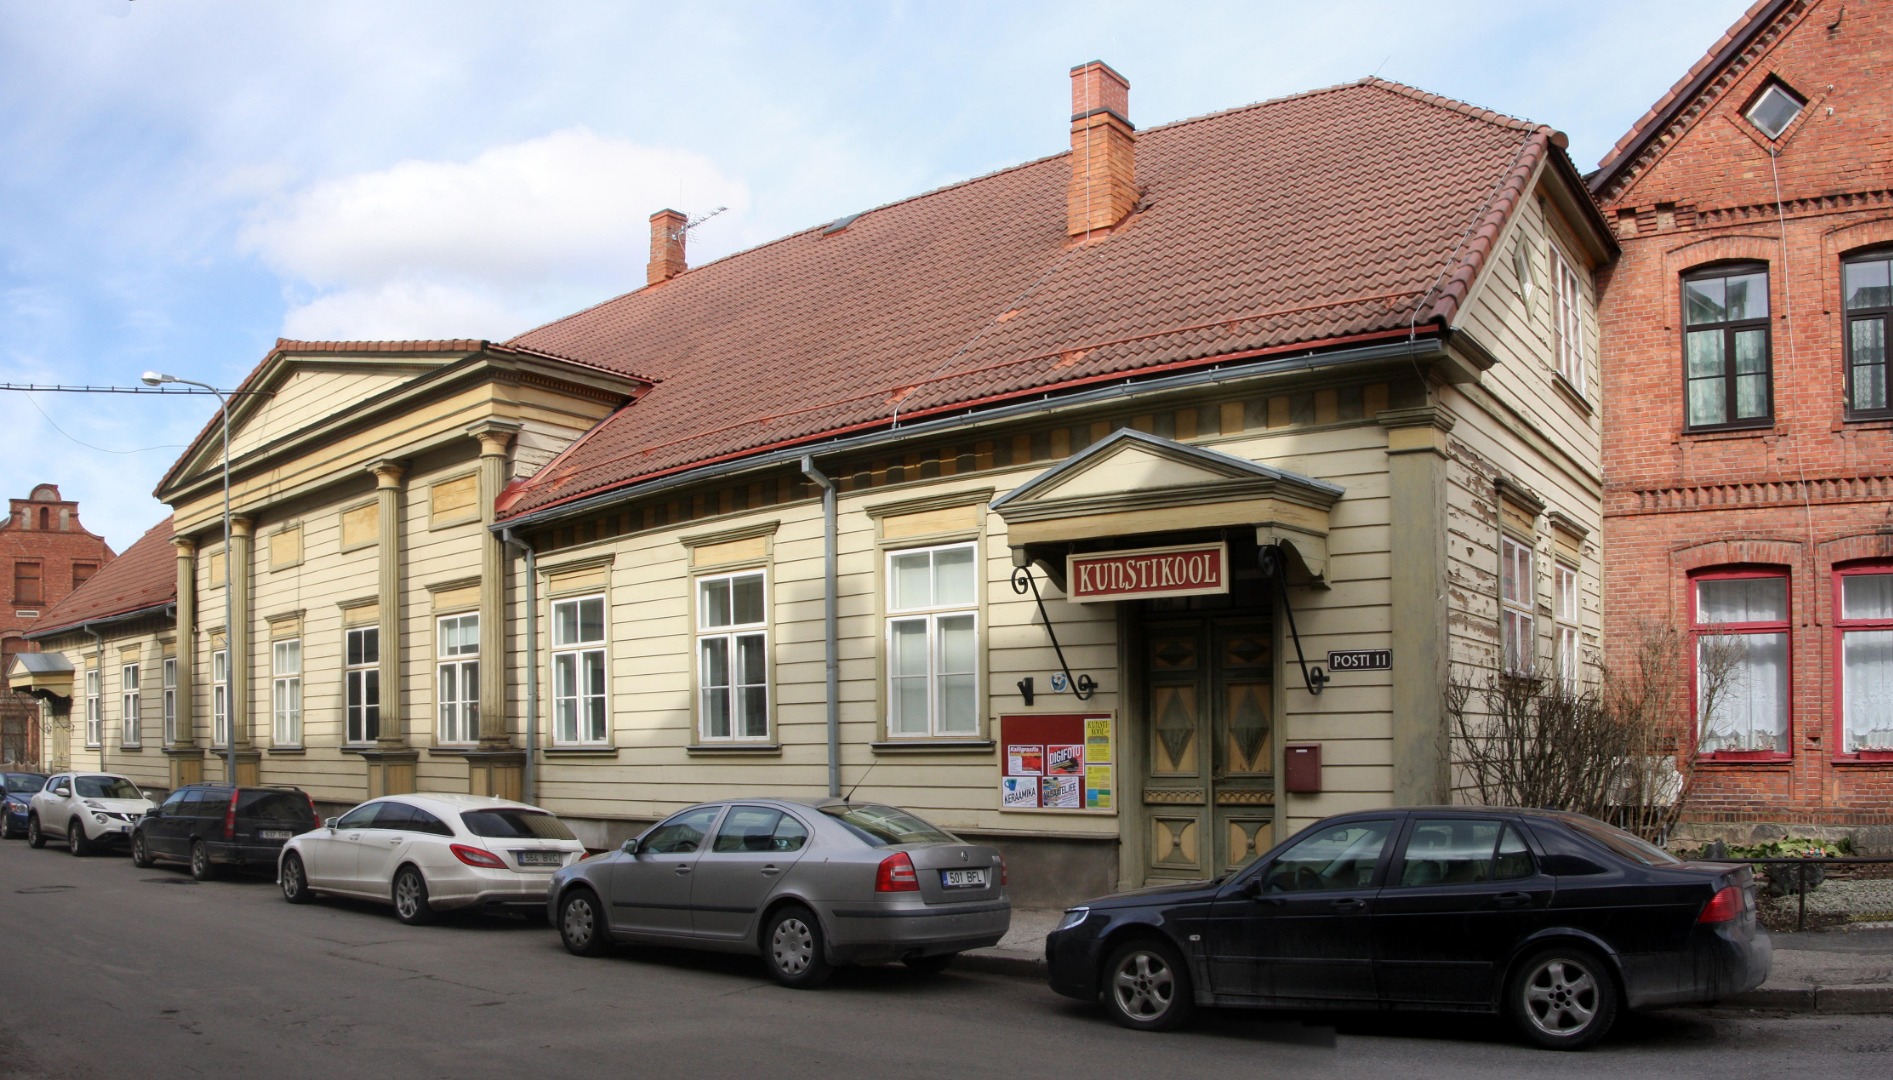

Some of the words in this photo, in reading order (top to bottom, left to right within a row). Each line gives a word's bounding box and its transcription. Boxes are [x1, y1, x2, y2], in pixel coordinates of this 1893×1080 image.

[1079, 554, 1216, 592] KUNSTIKOOL
[1334, 654, 1369, 667] POSTI
[1375, 654, 1386, 666] 11
[1049, 746, 1081, 765] DIGIFOTO
[1005, 787, 1036, 804] KERAAMIKA
[950, 872, 963, 883] 501
[966, 871, 982, 882] BFL
